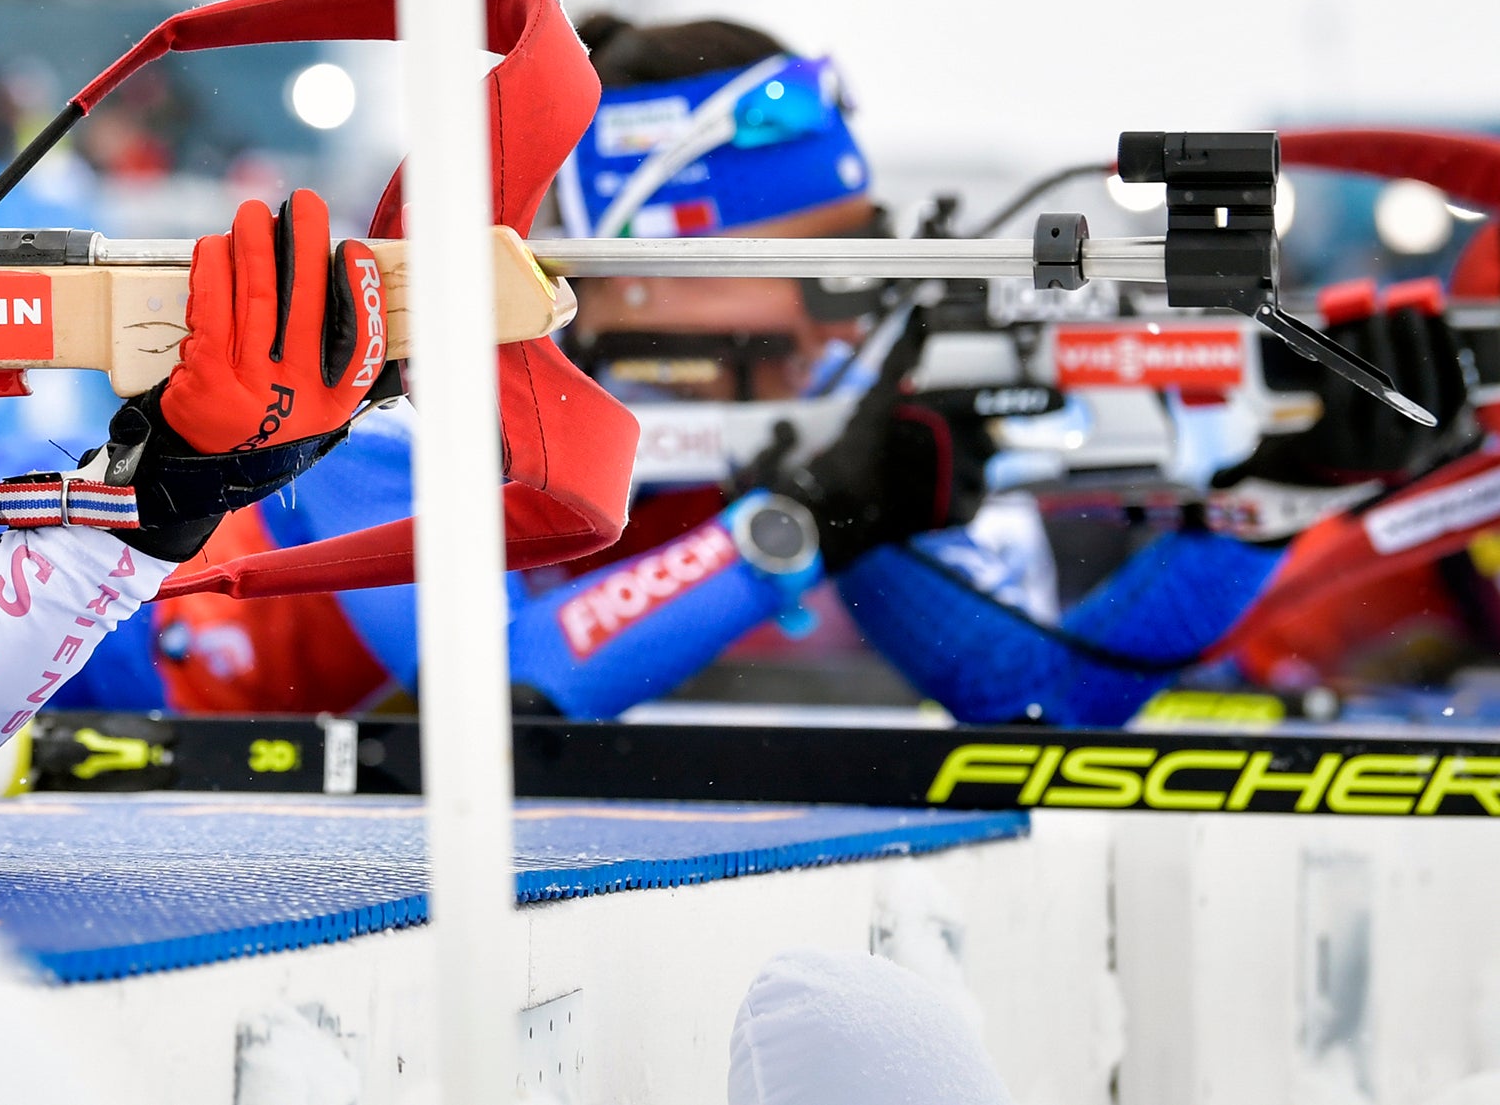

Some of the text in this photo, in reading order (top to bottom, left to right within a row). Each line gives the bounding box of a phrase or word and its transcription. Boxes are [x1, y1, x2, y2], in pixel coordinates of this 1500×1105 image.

[112, 455, 136, 476] SX
[0, 545, 137, 735] ARIENS
[925, 743, 1500, 816] FISCHER
